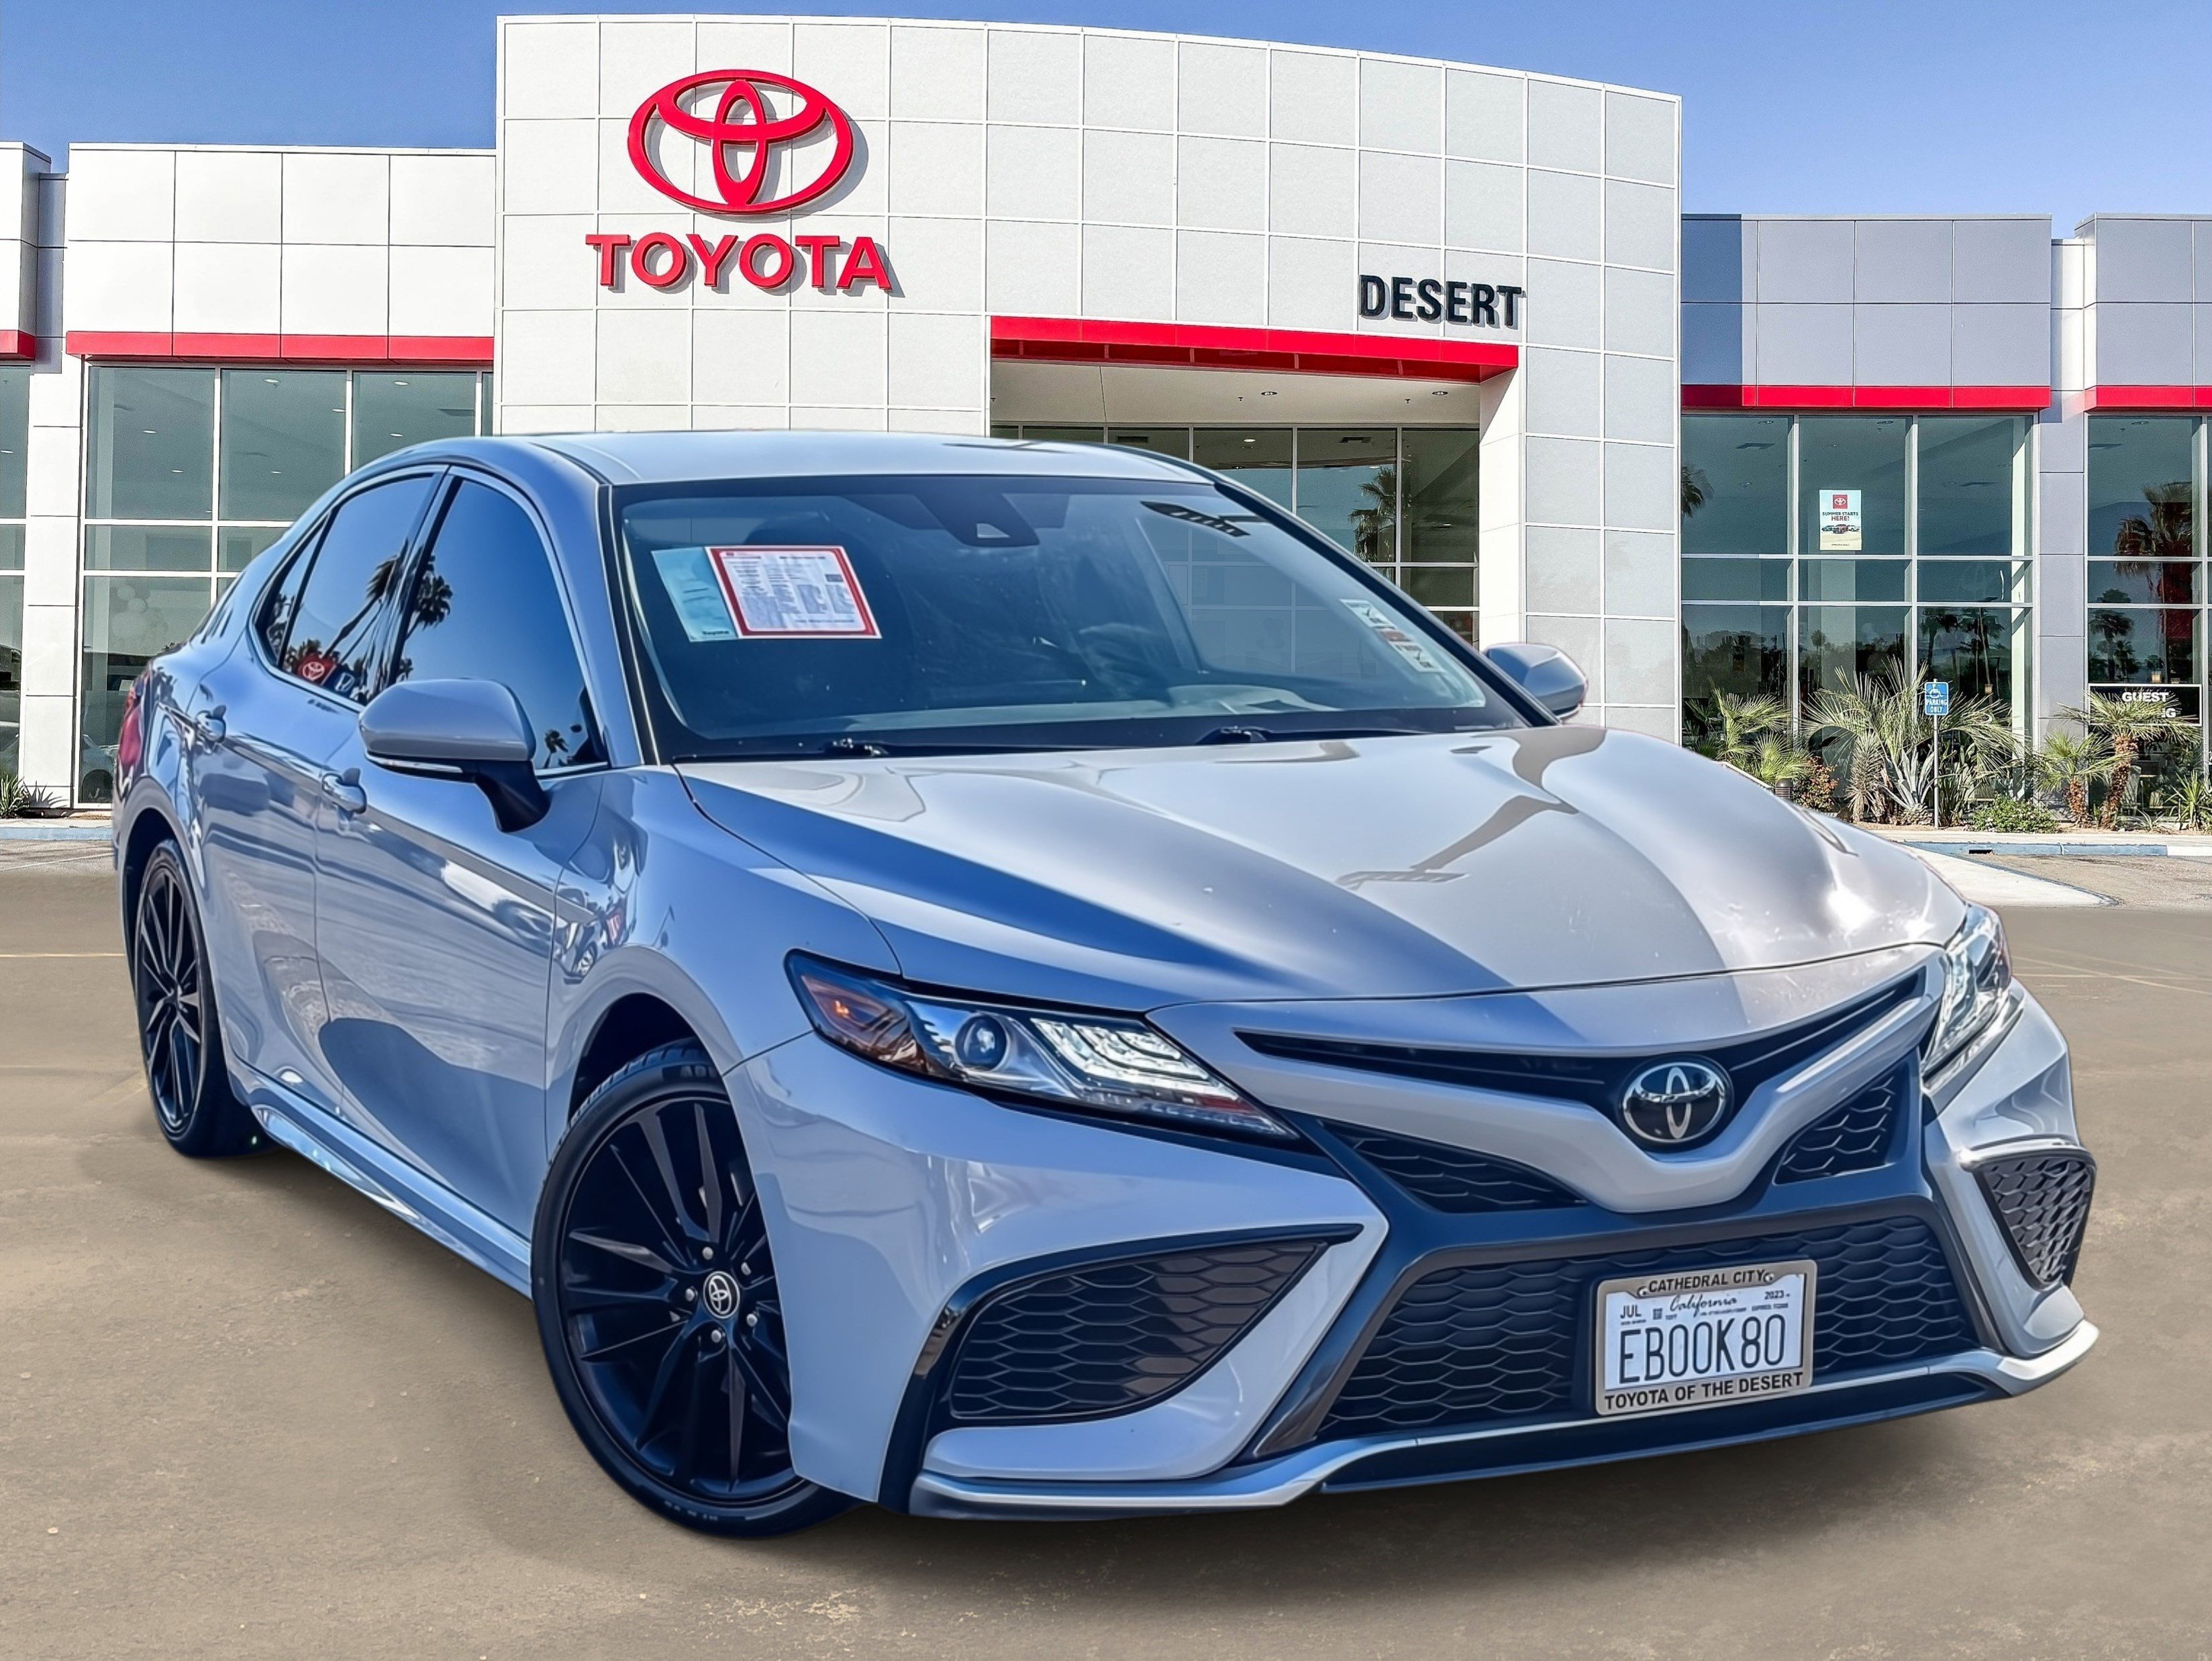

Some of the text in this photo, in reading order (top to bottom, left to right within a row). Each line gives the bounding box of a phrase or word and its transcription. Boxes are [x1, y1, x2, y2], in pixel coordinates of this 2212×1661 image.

[585, 232, 893, 290] TOYOTA
[1358, 274, 1522, 327] DESERT
[1930, 705, 1944, 713] ONLY
[2121, 691, 2170, 703] GUEST
[1648, 1269, 1766, 1293] CATHEDRAL CITY
[1620, 1305, 1642, 1319] JUL
[1670, 1293, 1738, 1317] California
[1605, 1372, 1803, 1409] TOYOTA OF THE DESERT
